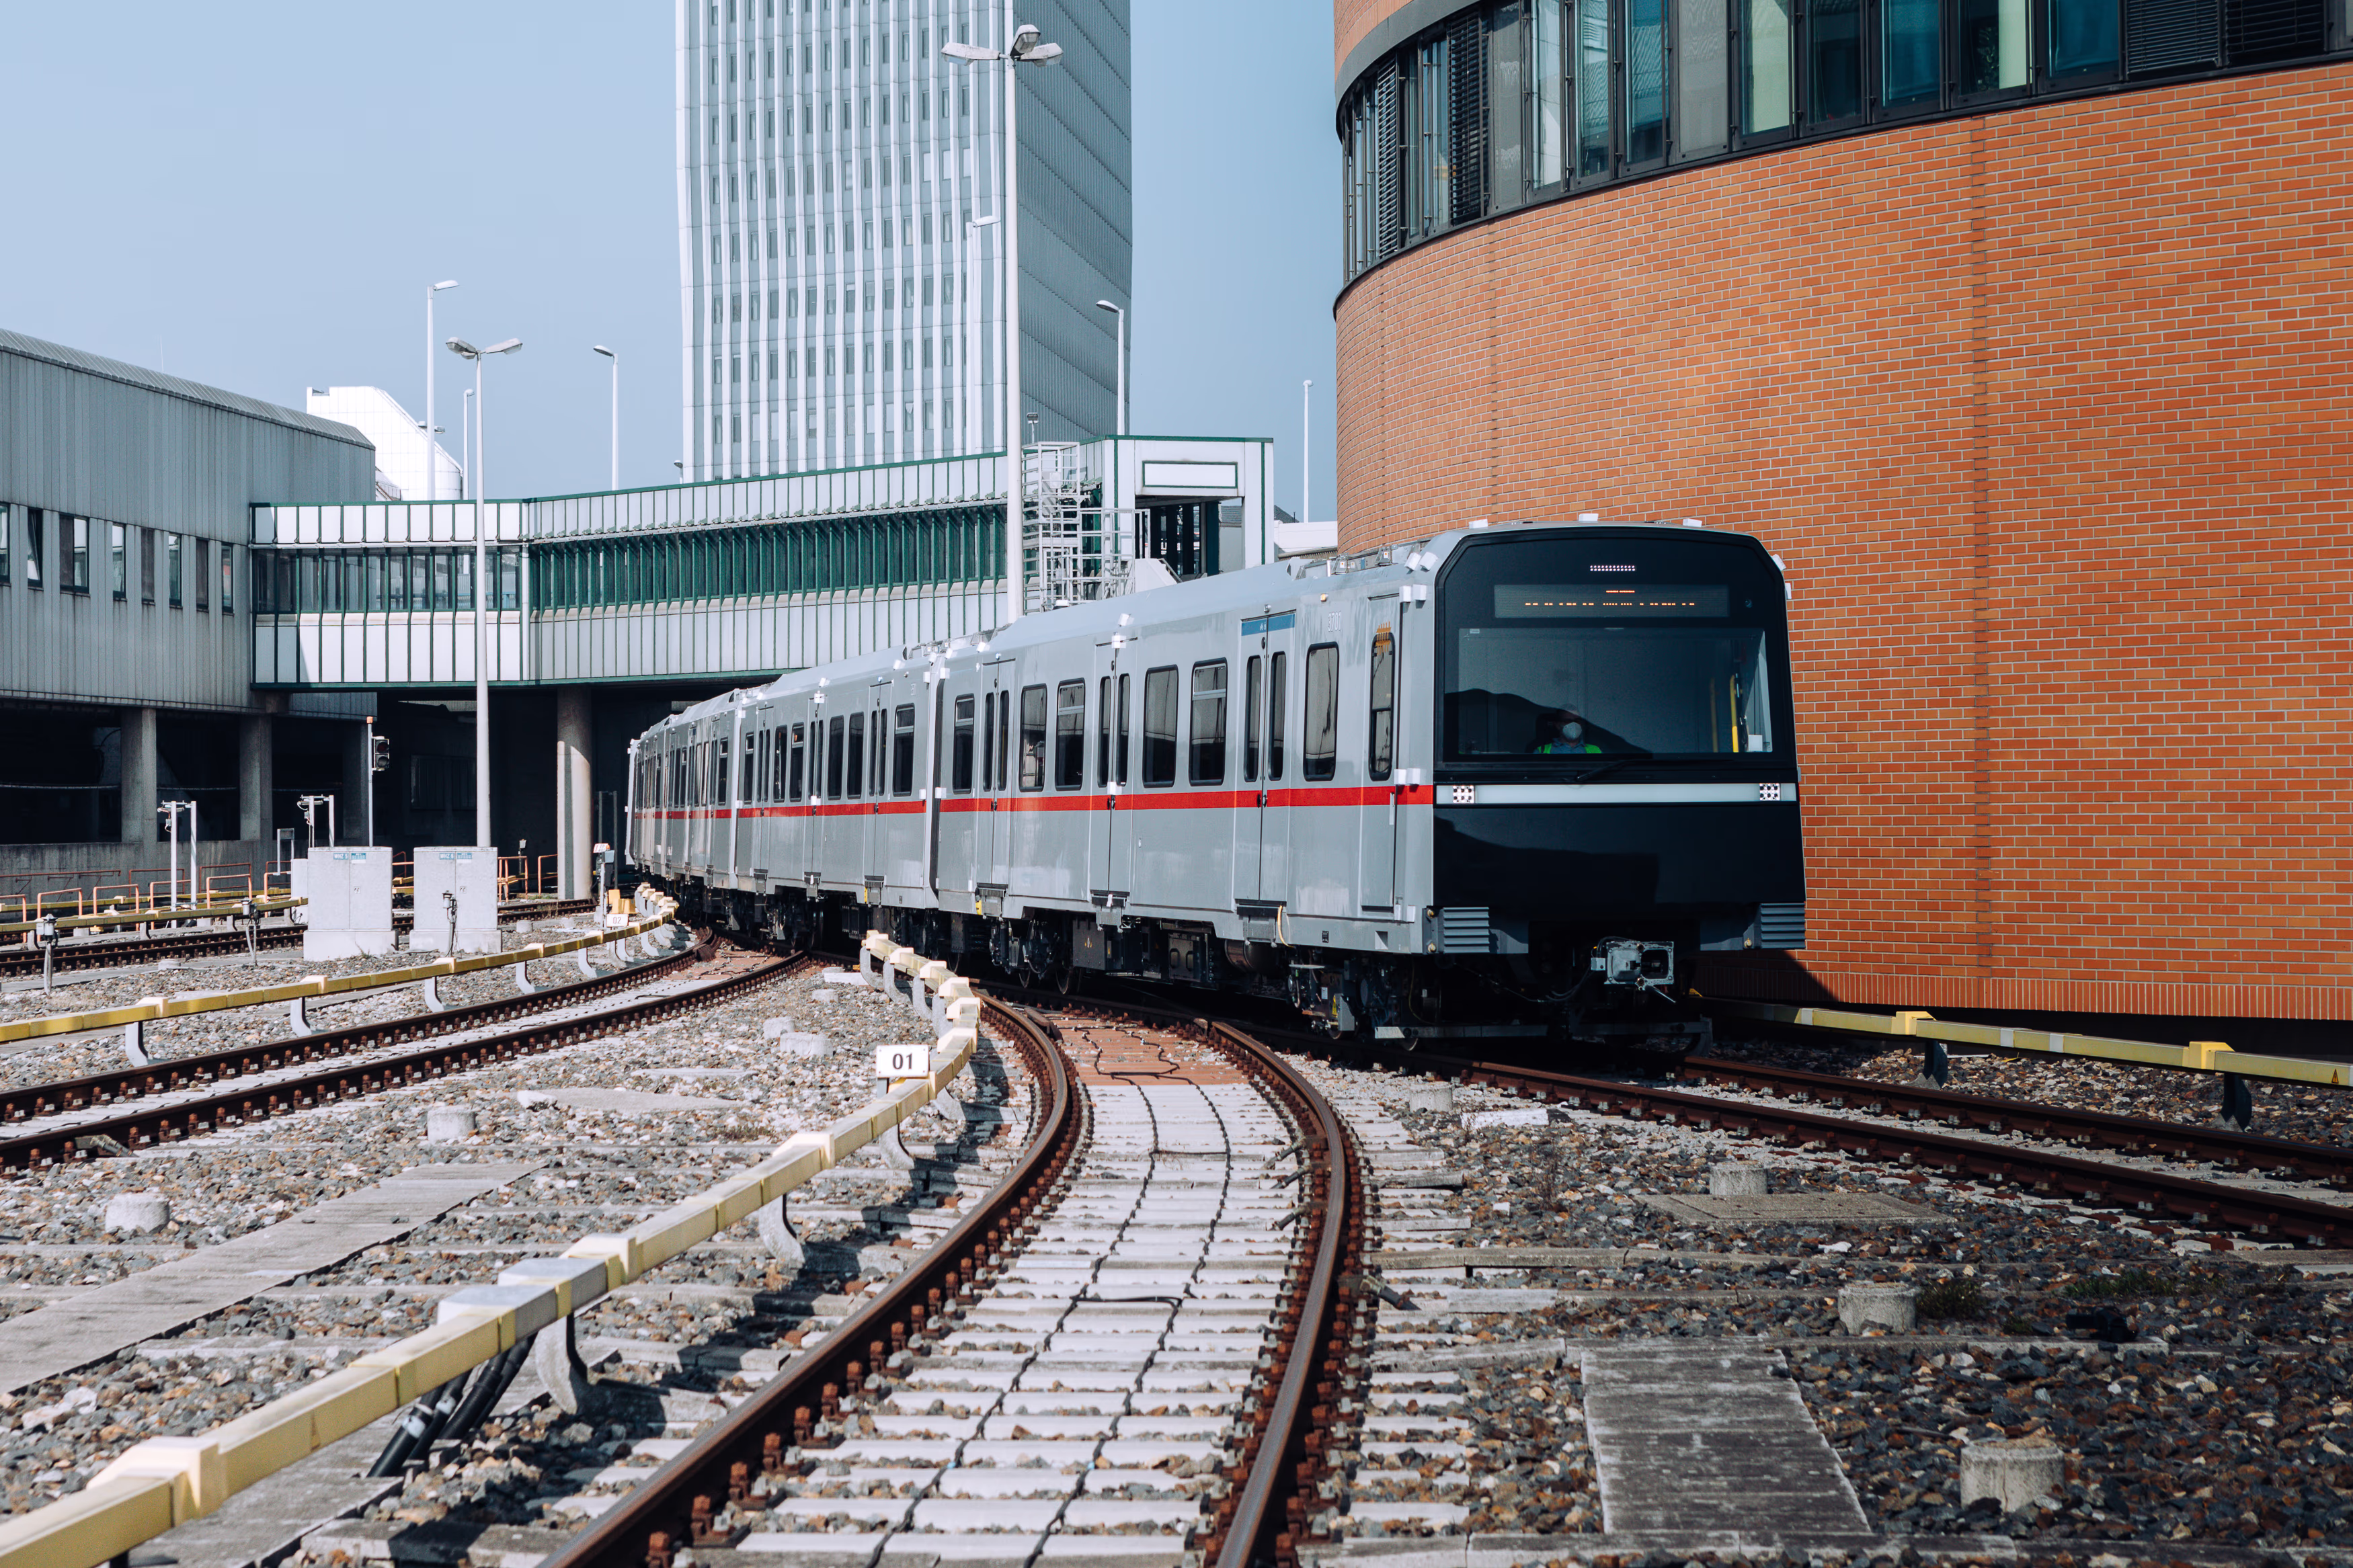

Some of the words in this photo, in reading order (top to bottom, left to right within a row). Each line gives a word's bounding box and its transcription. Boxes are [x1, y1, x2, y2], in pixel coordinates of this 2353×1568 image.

[1328, 610, 1341, 632] 3701
[612, 916, 622, 924] 02
[892, 1053, 913, 1070] 01
